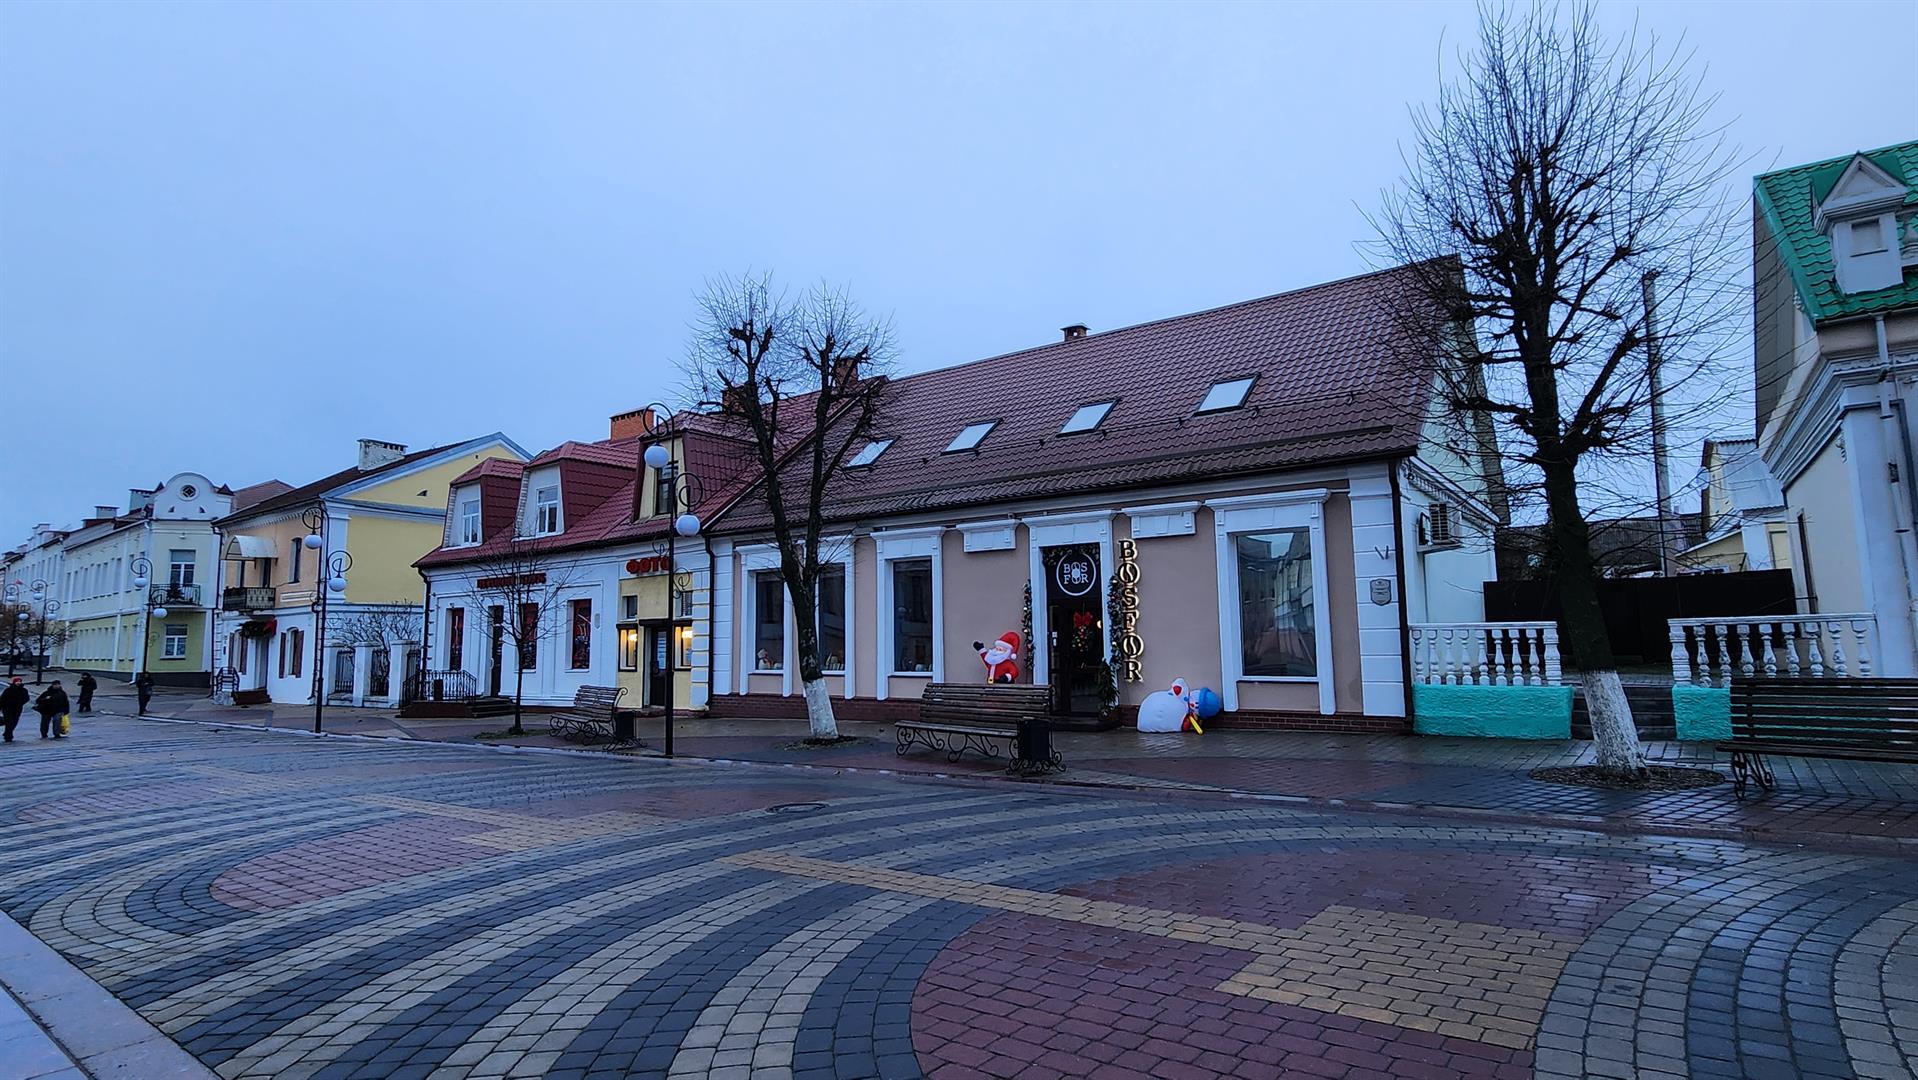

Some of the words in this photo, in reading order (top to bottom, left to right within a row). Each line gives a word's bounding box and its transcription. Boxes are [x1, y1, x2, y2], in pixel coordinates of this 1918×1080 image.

[1063, 562, 1088, 574] BOS
[1063, 573, 1089, 584] FOR
[1118, 539, 1143, 682] BOSFOR
